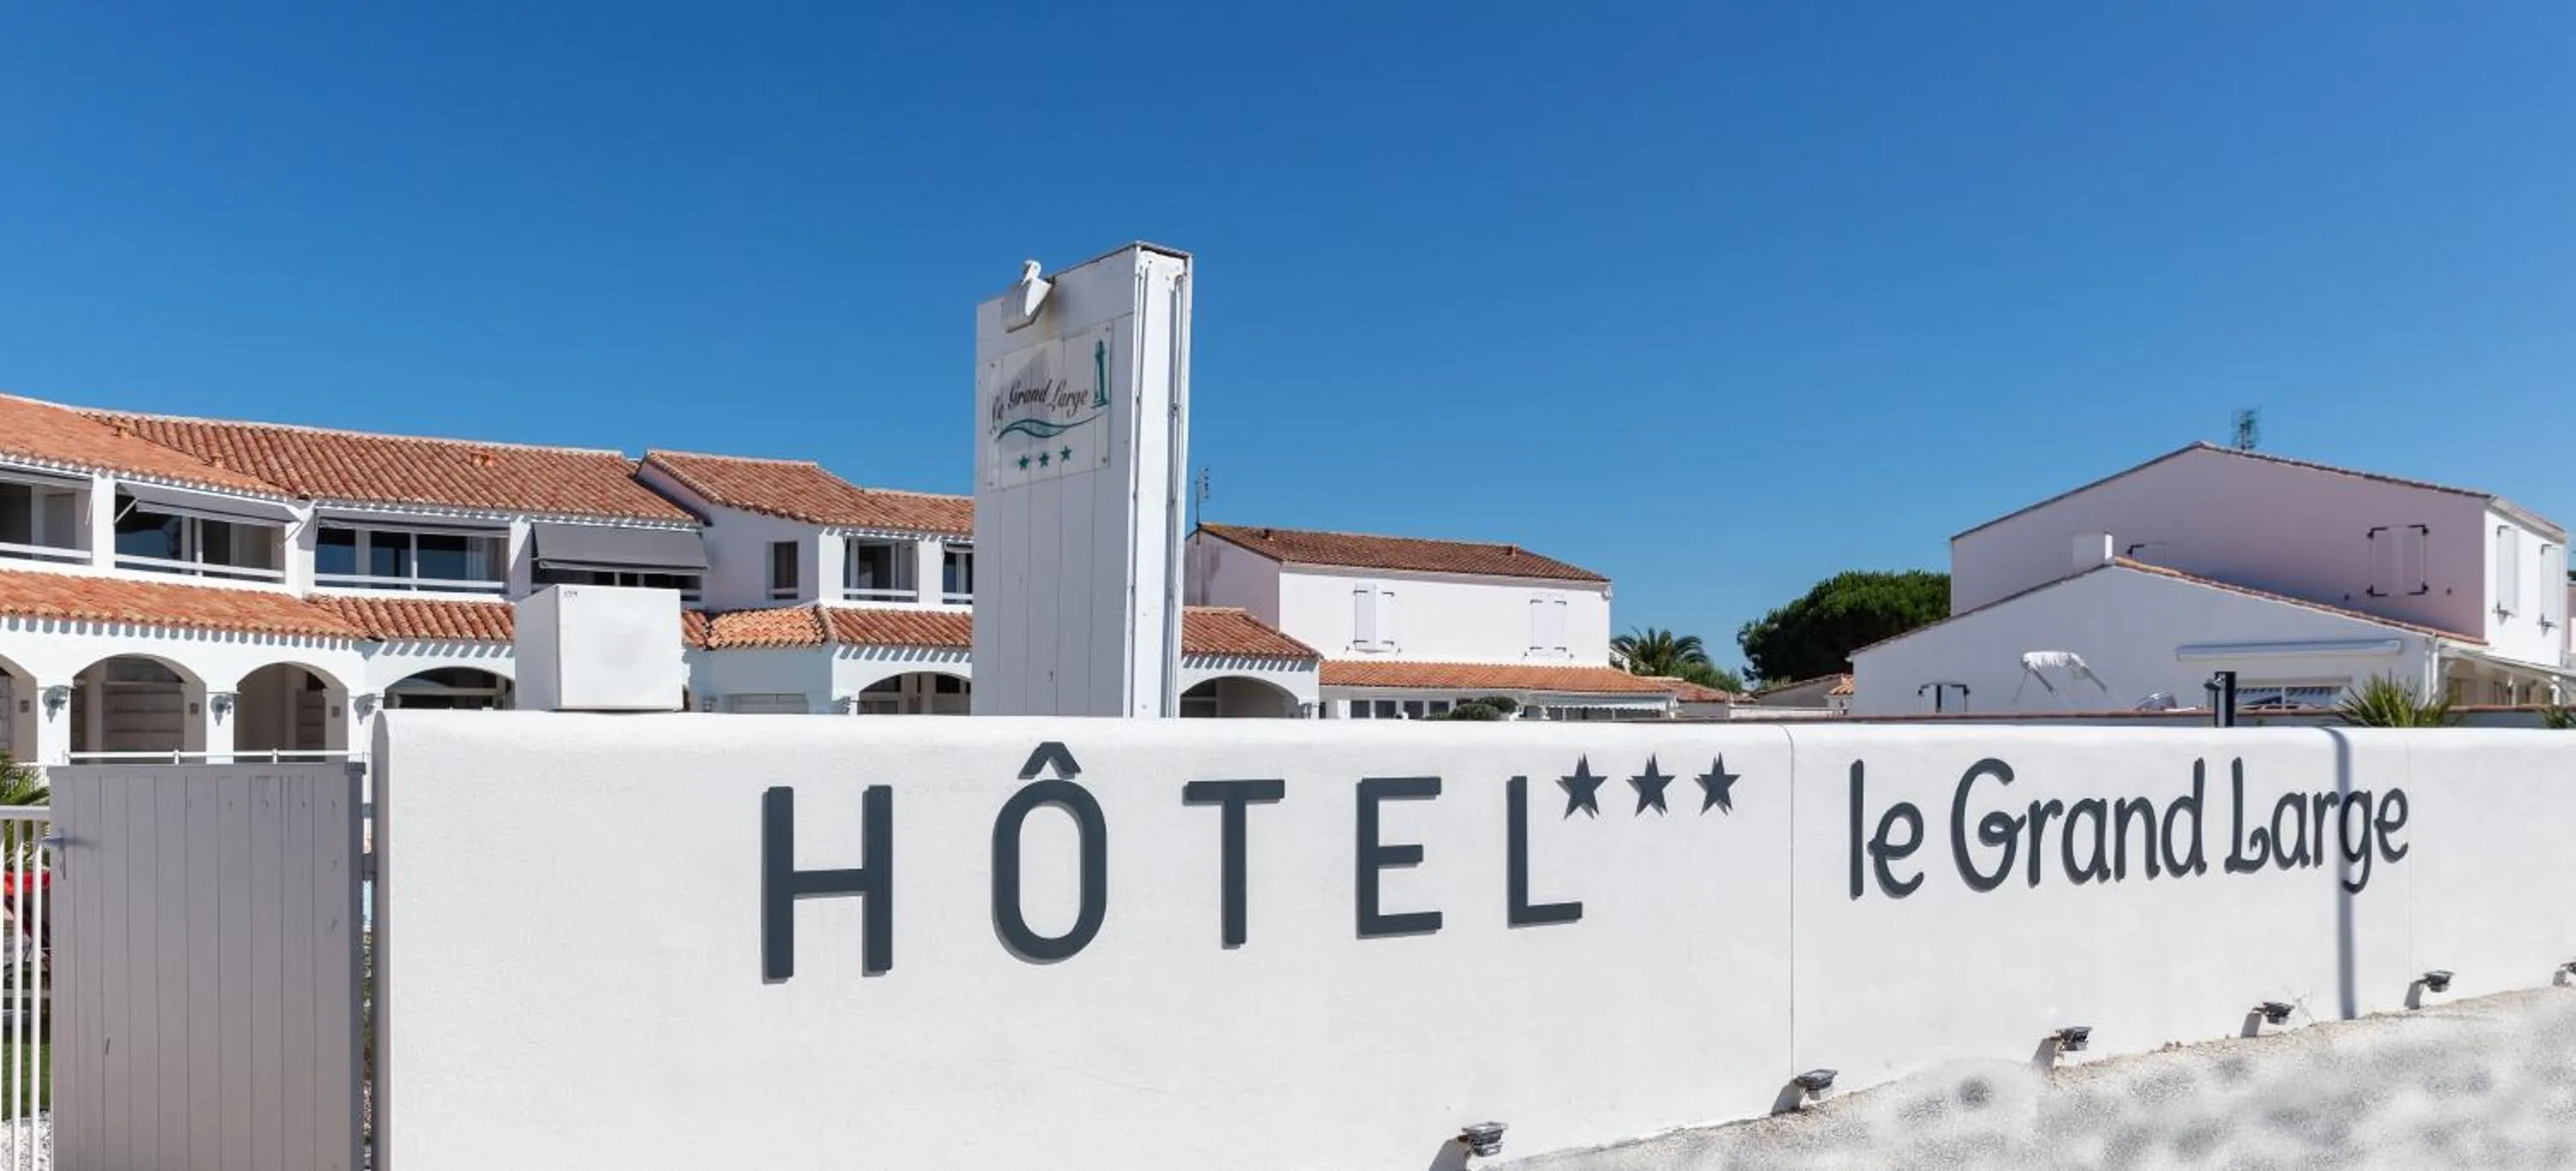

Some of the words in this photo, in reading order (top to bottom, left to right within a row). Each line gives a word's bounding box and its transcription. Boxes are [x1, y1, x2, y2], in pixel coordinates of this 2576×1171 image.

[1007, 379, 1054, 410] Grand
[1047, 379, 1089, 418] Large
[762, 741, 1583, 984] HÔTEL
[1850, 759, 1924, 899] le
[1950, 757, 2208, 894] Grand
[2224, 756, 2409, 895] Large
